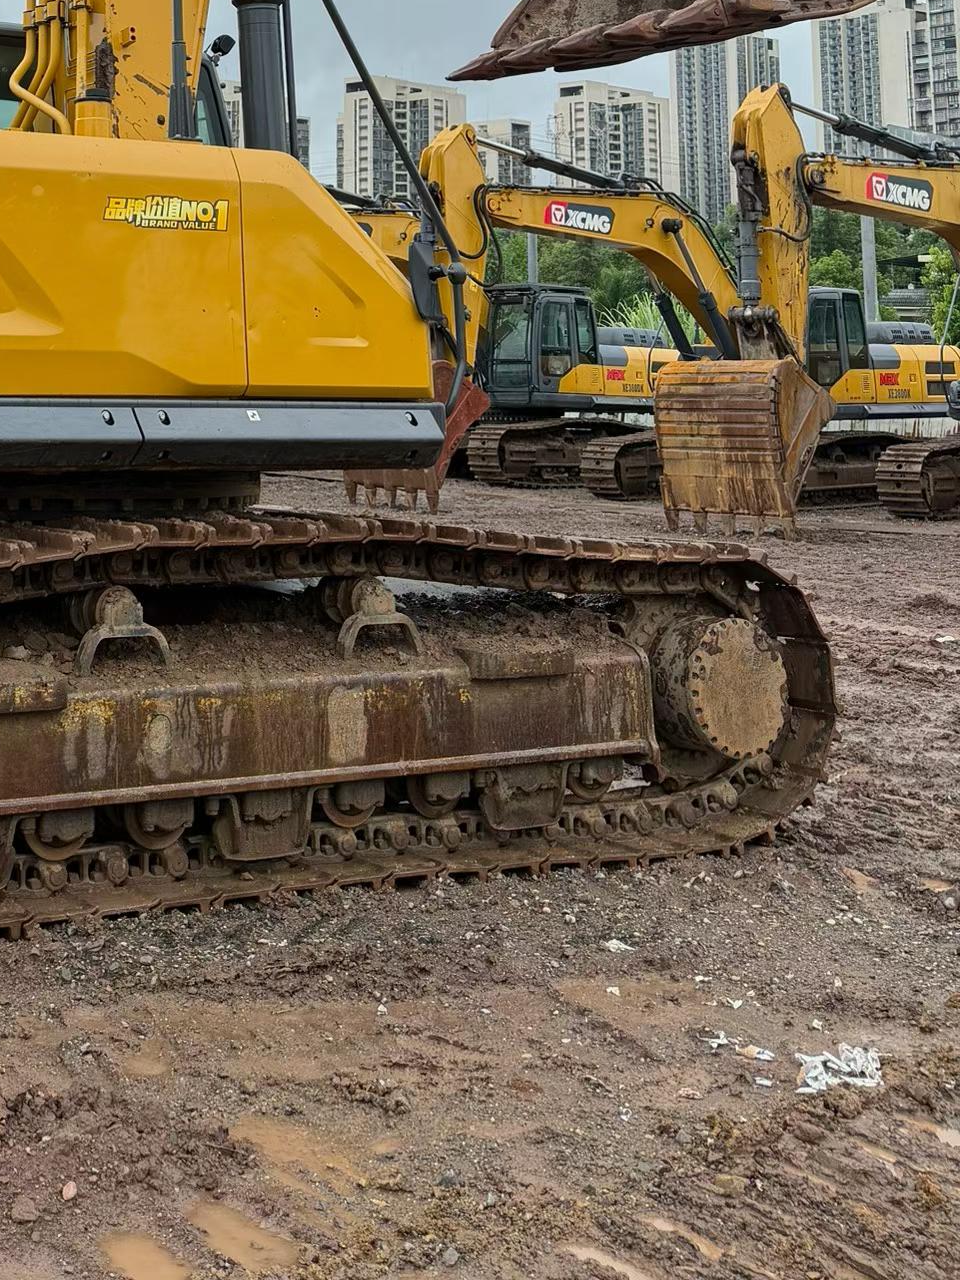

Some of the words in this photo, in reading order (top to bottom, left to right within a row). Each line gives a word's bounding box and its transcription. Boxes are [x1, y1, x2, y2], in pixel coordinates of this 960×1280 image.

[885, 182, 931, 211] XCMG
[142, 220, 177, 229] BRAND
[182, 221, 215, 230] VALUE
[565, 209, 611, 233] XCMG
